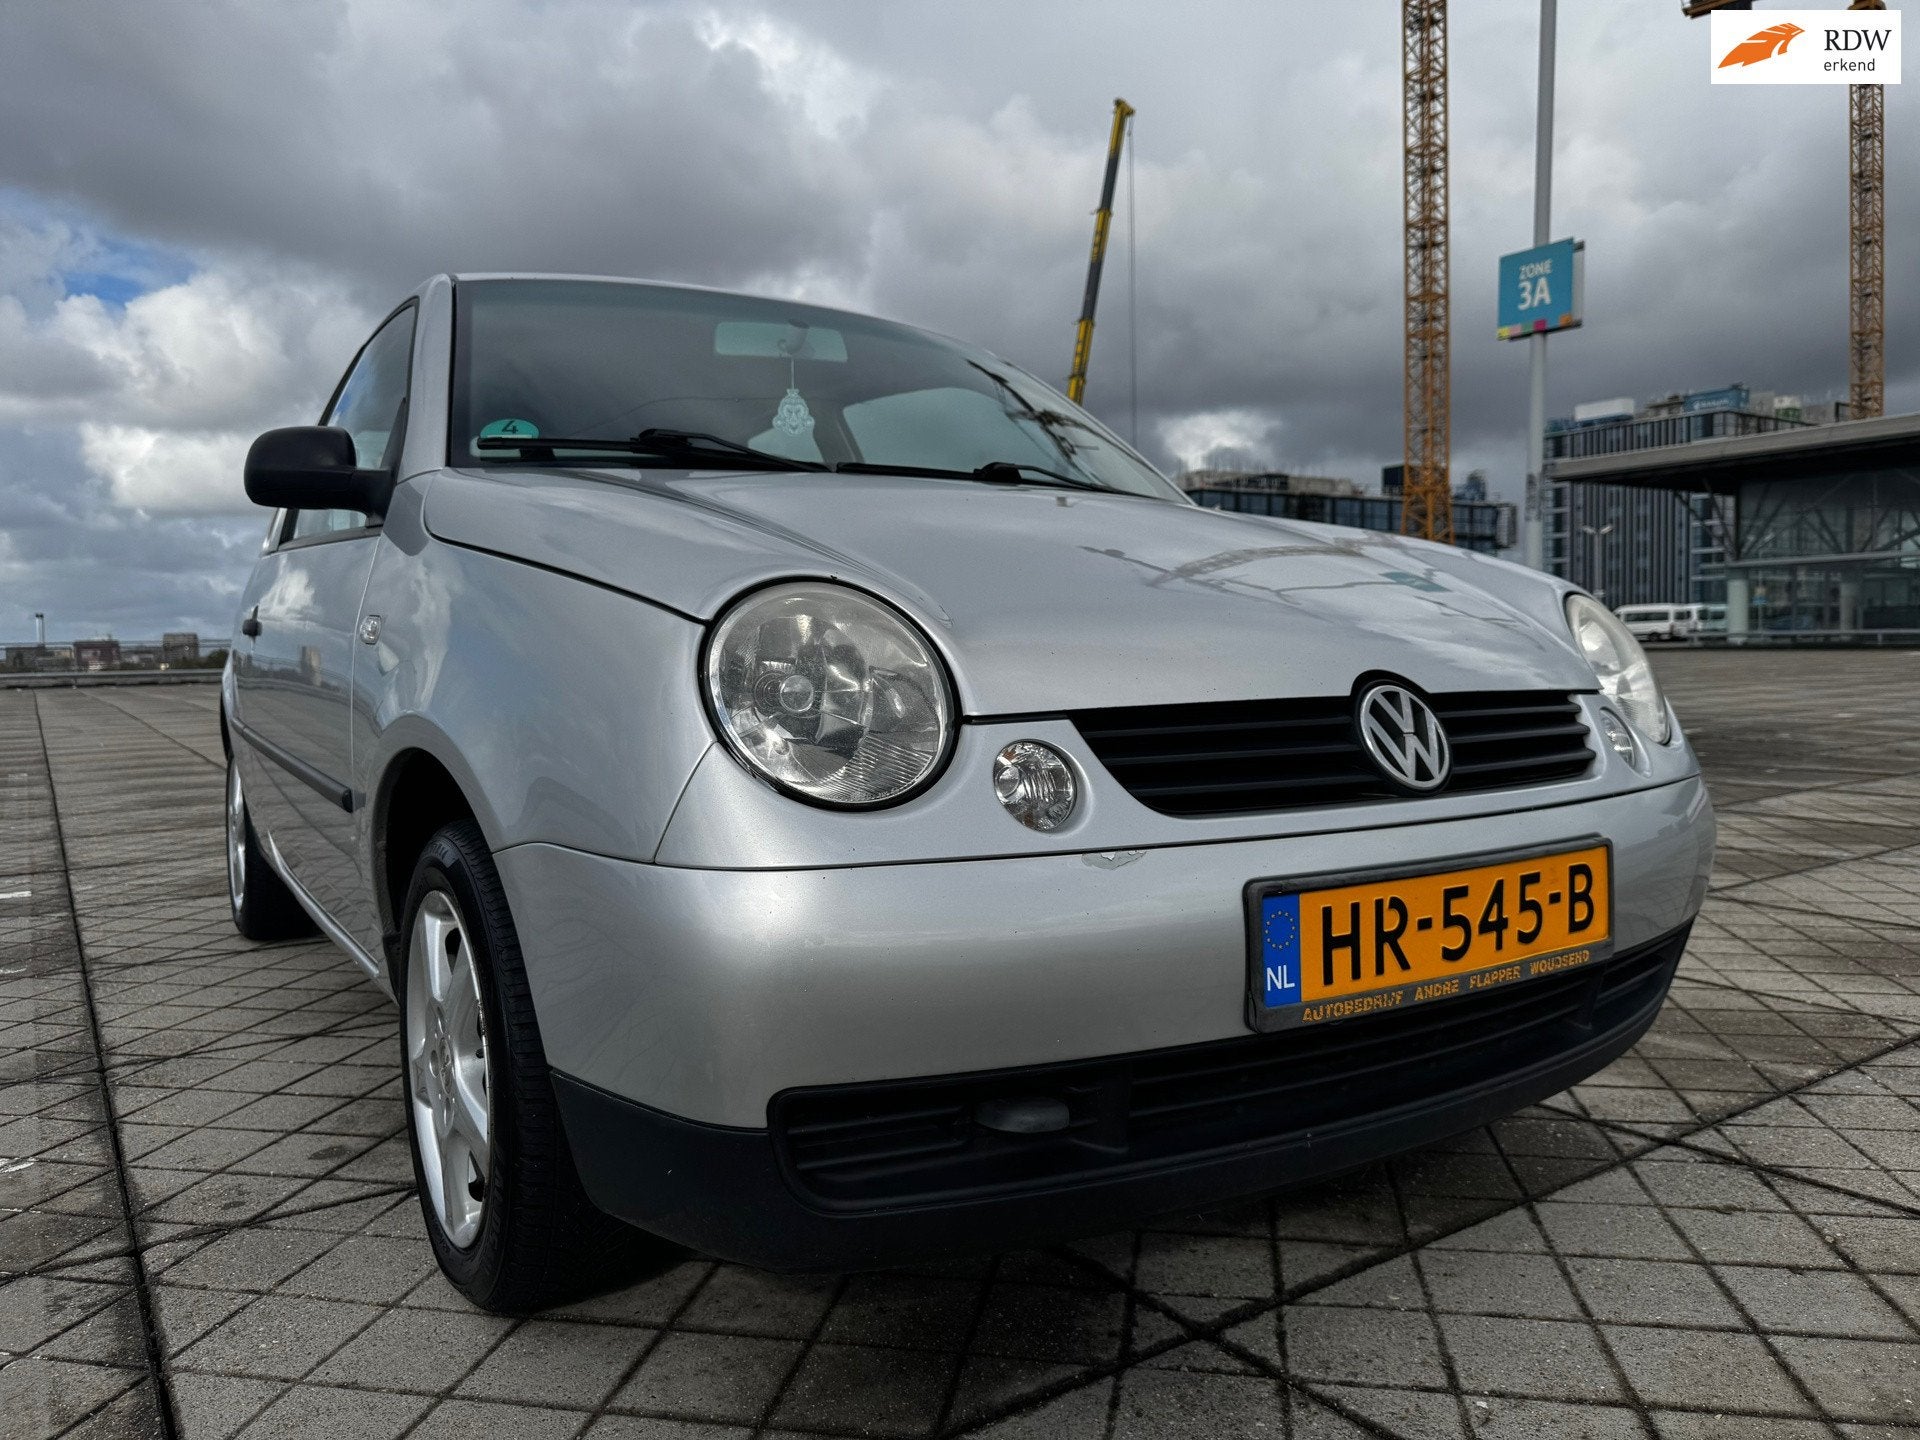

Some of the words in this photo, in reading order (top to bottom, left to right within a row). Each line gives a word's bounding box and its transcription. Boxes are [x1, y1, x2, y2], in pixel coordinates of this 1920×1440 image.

[1518, 258, 1553, 280] ZONE
[1517, 277, 1552, 311] 3A
[501, 419, 519, 435] 4
[1362, 686, 1449, 787] VW
[1321, 863, 1595, 987] HR-545-B
[1266, 965, 1295, 992] NL
[1303, 990, 1404, 1023] AUTOBEDRIJF
[1414, 979, 1460, 1001] ANDRE
[1469, 965, 1521, 989] FLAPPER
